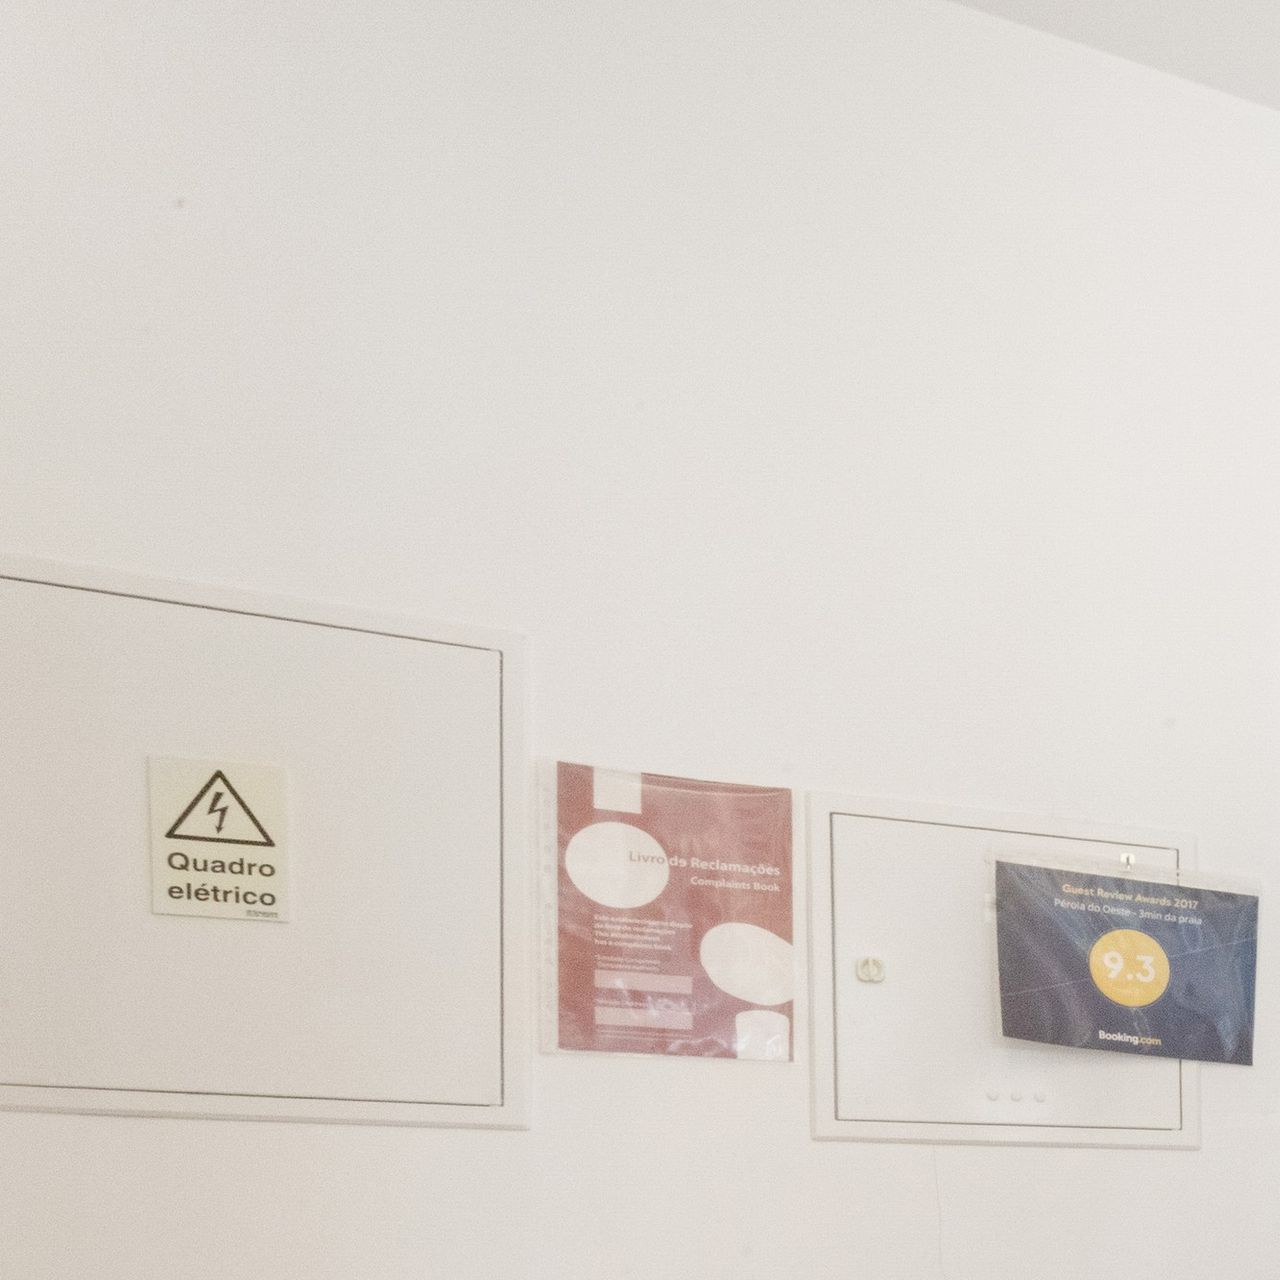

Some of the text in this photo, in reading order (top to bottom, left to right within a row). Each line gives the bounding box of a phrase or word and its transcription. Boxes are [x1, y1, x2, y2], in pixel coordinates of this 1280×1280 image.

[167, 852, 275, 877] Quadro
[628, 851, 780, 876] Livro de Reclamações
[168, 883, 276, 906] elétrico
[690, 876, 780, 892] Complaints Book
[1062, 884, 1199, 909] Guest Review Awards 2017
[1054, 898, 1085, 912] Pérola
[1087, 902, 1100, 913] do
[1103, 904, 1131, 917] Oeste
[1139, 909, 1162, 920] 3min
[1164, 912, 1176, 922] da
[1178, 915, 1203, 925] praia
[1103, 951, 1156, 983] 9.3
[1098, 1030, 1162, 1045] Booking.com
